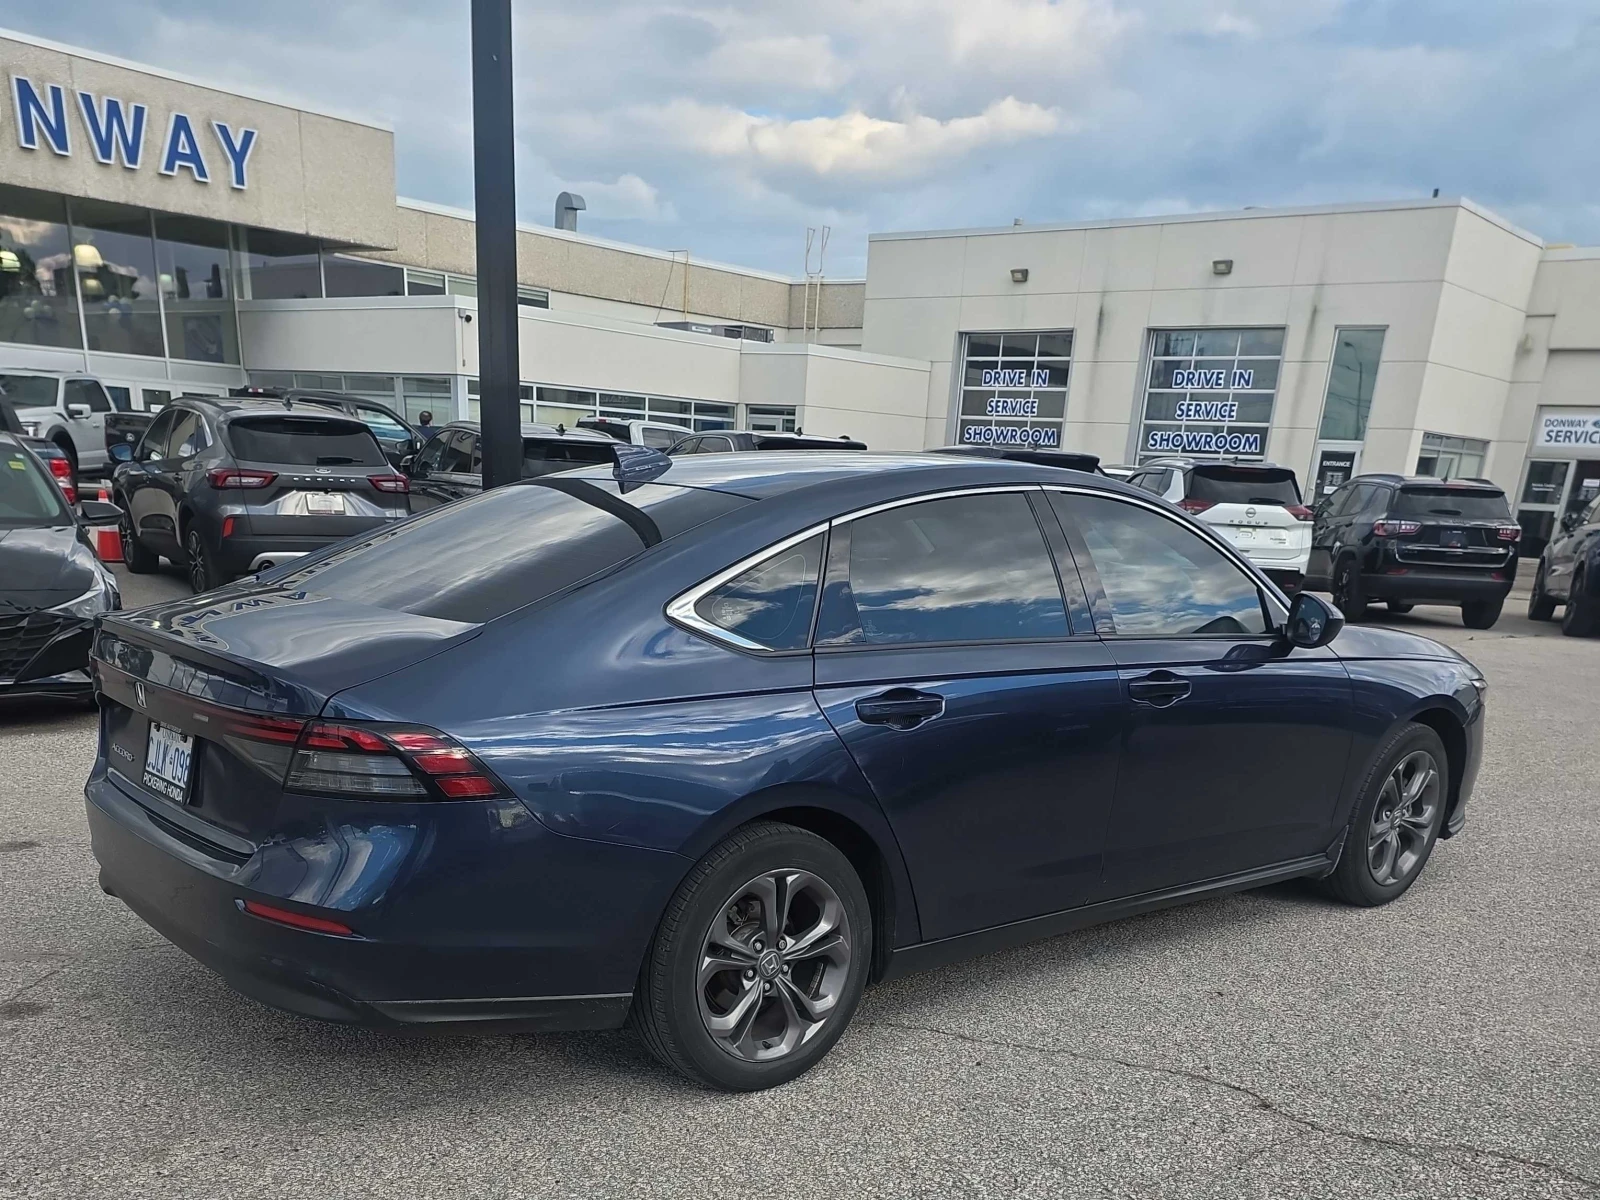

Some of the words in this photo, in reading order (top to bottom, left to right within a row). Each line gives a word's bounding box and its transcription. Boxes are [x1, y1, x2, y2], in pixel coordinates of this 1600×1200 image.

[10, 74, 258, 190] NWAY
[982, 369, 1026, 386] DRIVE
[1030, 369, 1049, 387] IN
[1172, 369, 1226, 389] DRIVE
[1230, 369, 1253, 388] IN
[986, 398, 1039, 416] SERVICE
[1175, 401, 1238, 420] SERVICE
[1544, 418, 1588, 428] DONWAY
[964, 425, 1057, 445] SHOWROOM
[1148, 431, 1260, 452] SHOWROOM
[1545, 429, 1600, 444] SERVIC
[1322, 460, 1351, 468] ENTRANCE
[142, 772, 168, 794] PICKERING
[167, 783, 184, 803] HONDA
